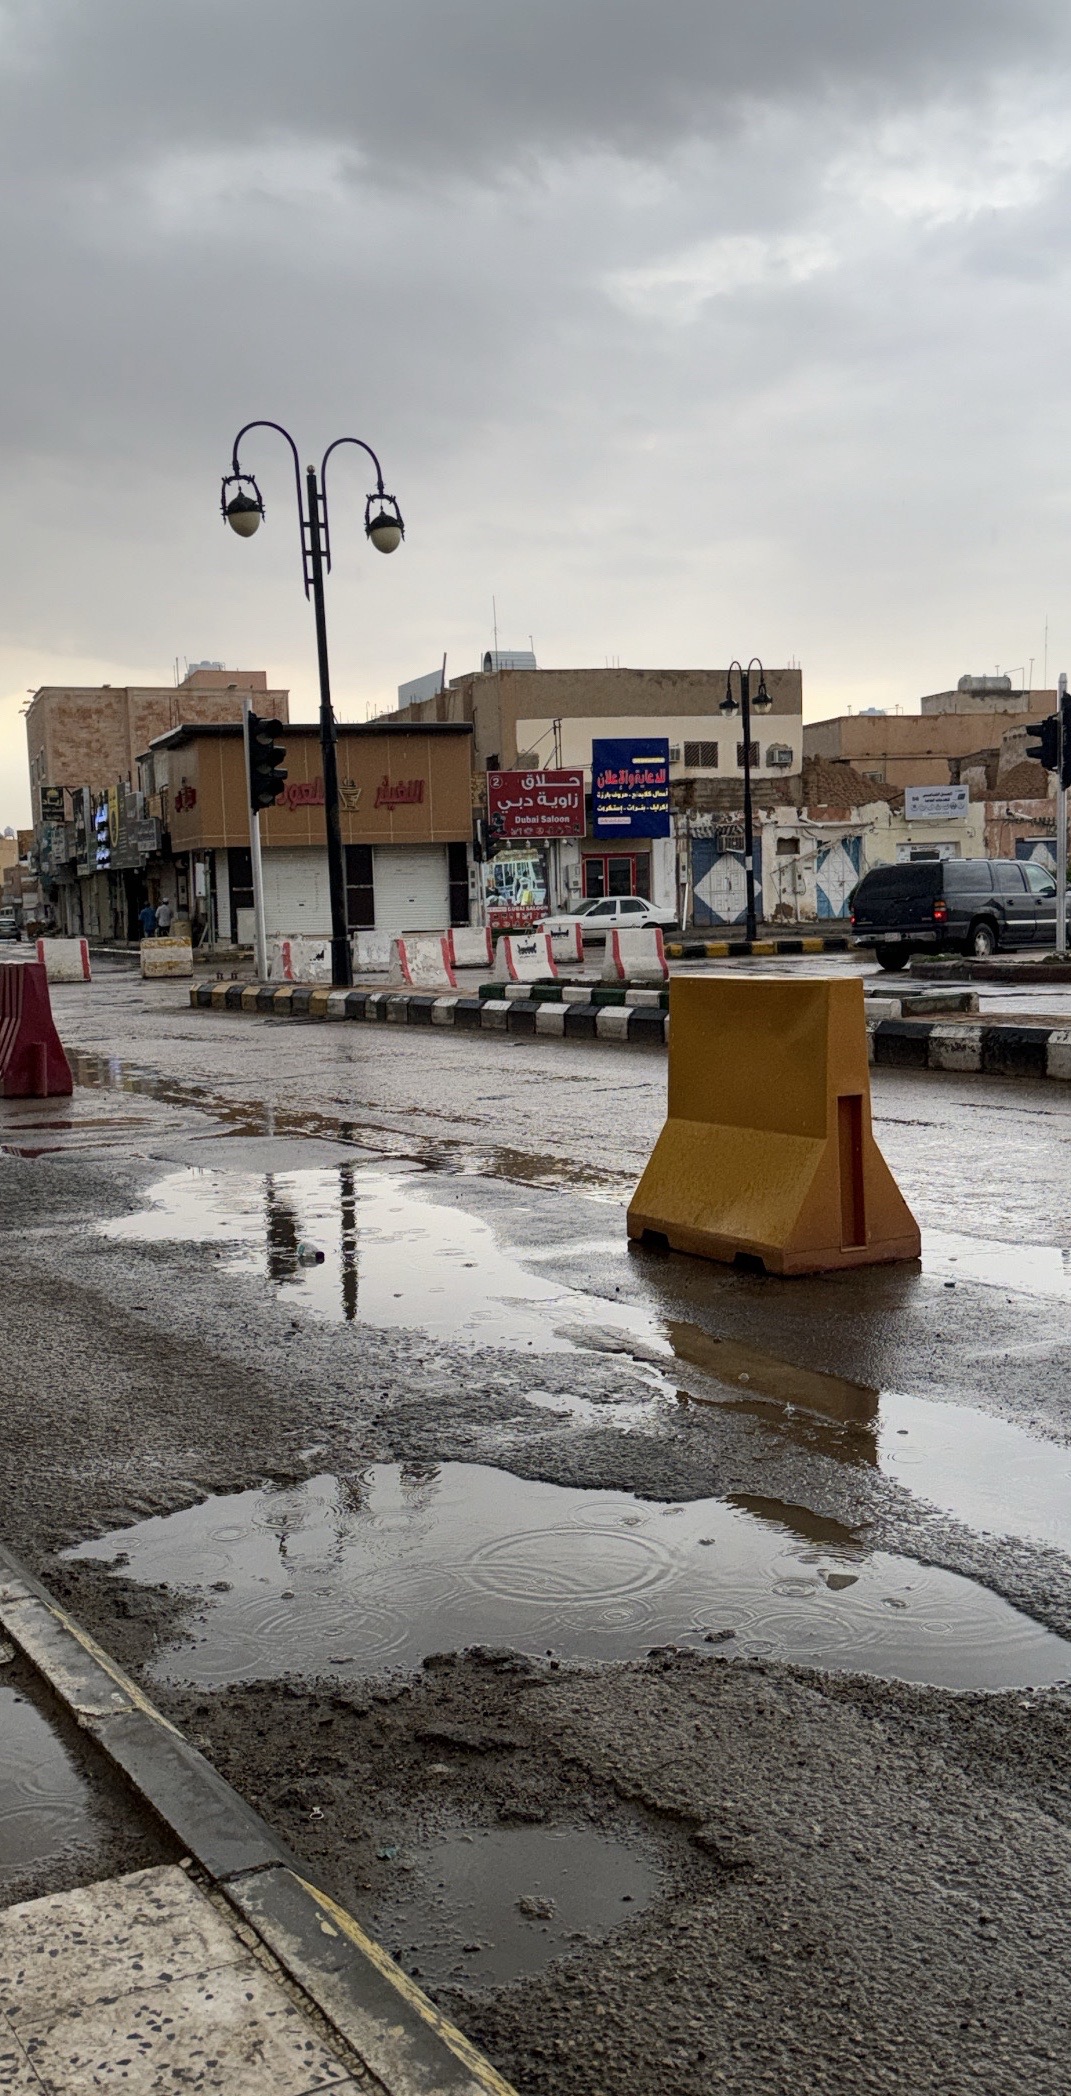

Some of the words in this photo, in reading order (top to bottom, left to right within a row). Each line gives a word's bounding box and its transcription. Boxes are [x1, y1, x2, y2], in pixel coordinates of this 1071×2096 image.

[492, 778, 500, 787] 2
[521, 774, 580, 790] حلاق
[597, 769, 635, 790] والإعلان
[635, 769, 666, 788] للدعاية
[497, 796, 534, 814] دبي
[536, 792, 579, 809] زاوية
[514, 815, 539, 824] Dubai
[541, 815, 570, 823] Saloon
